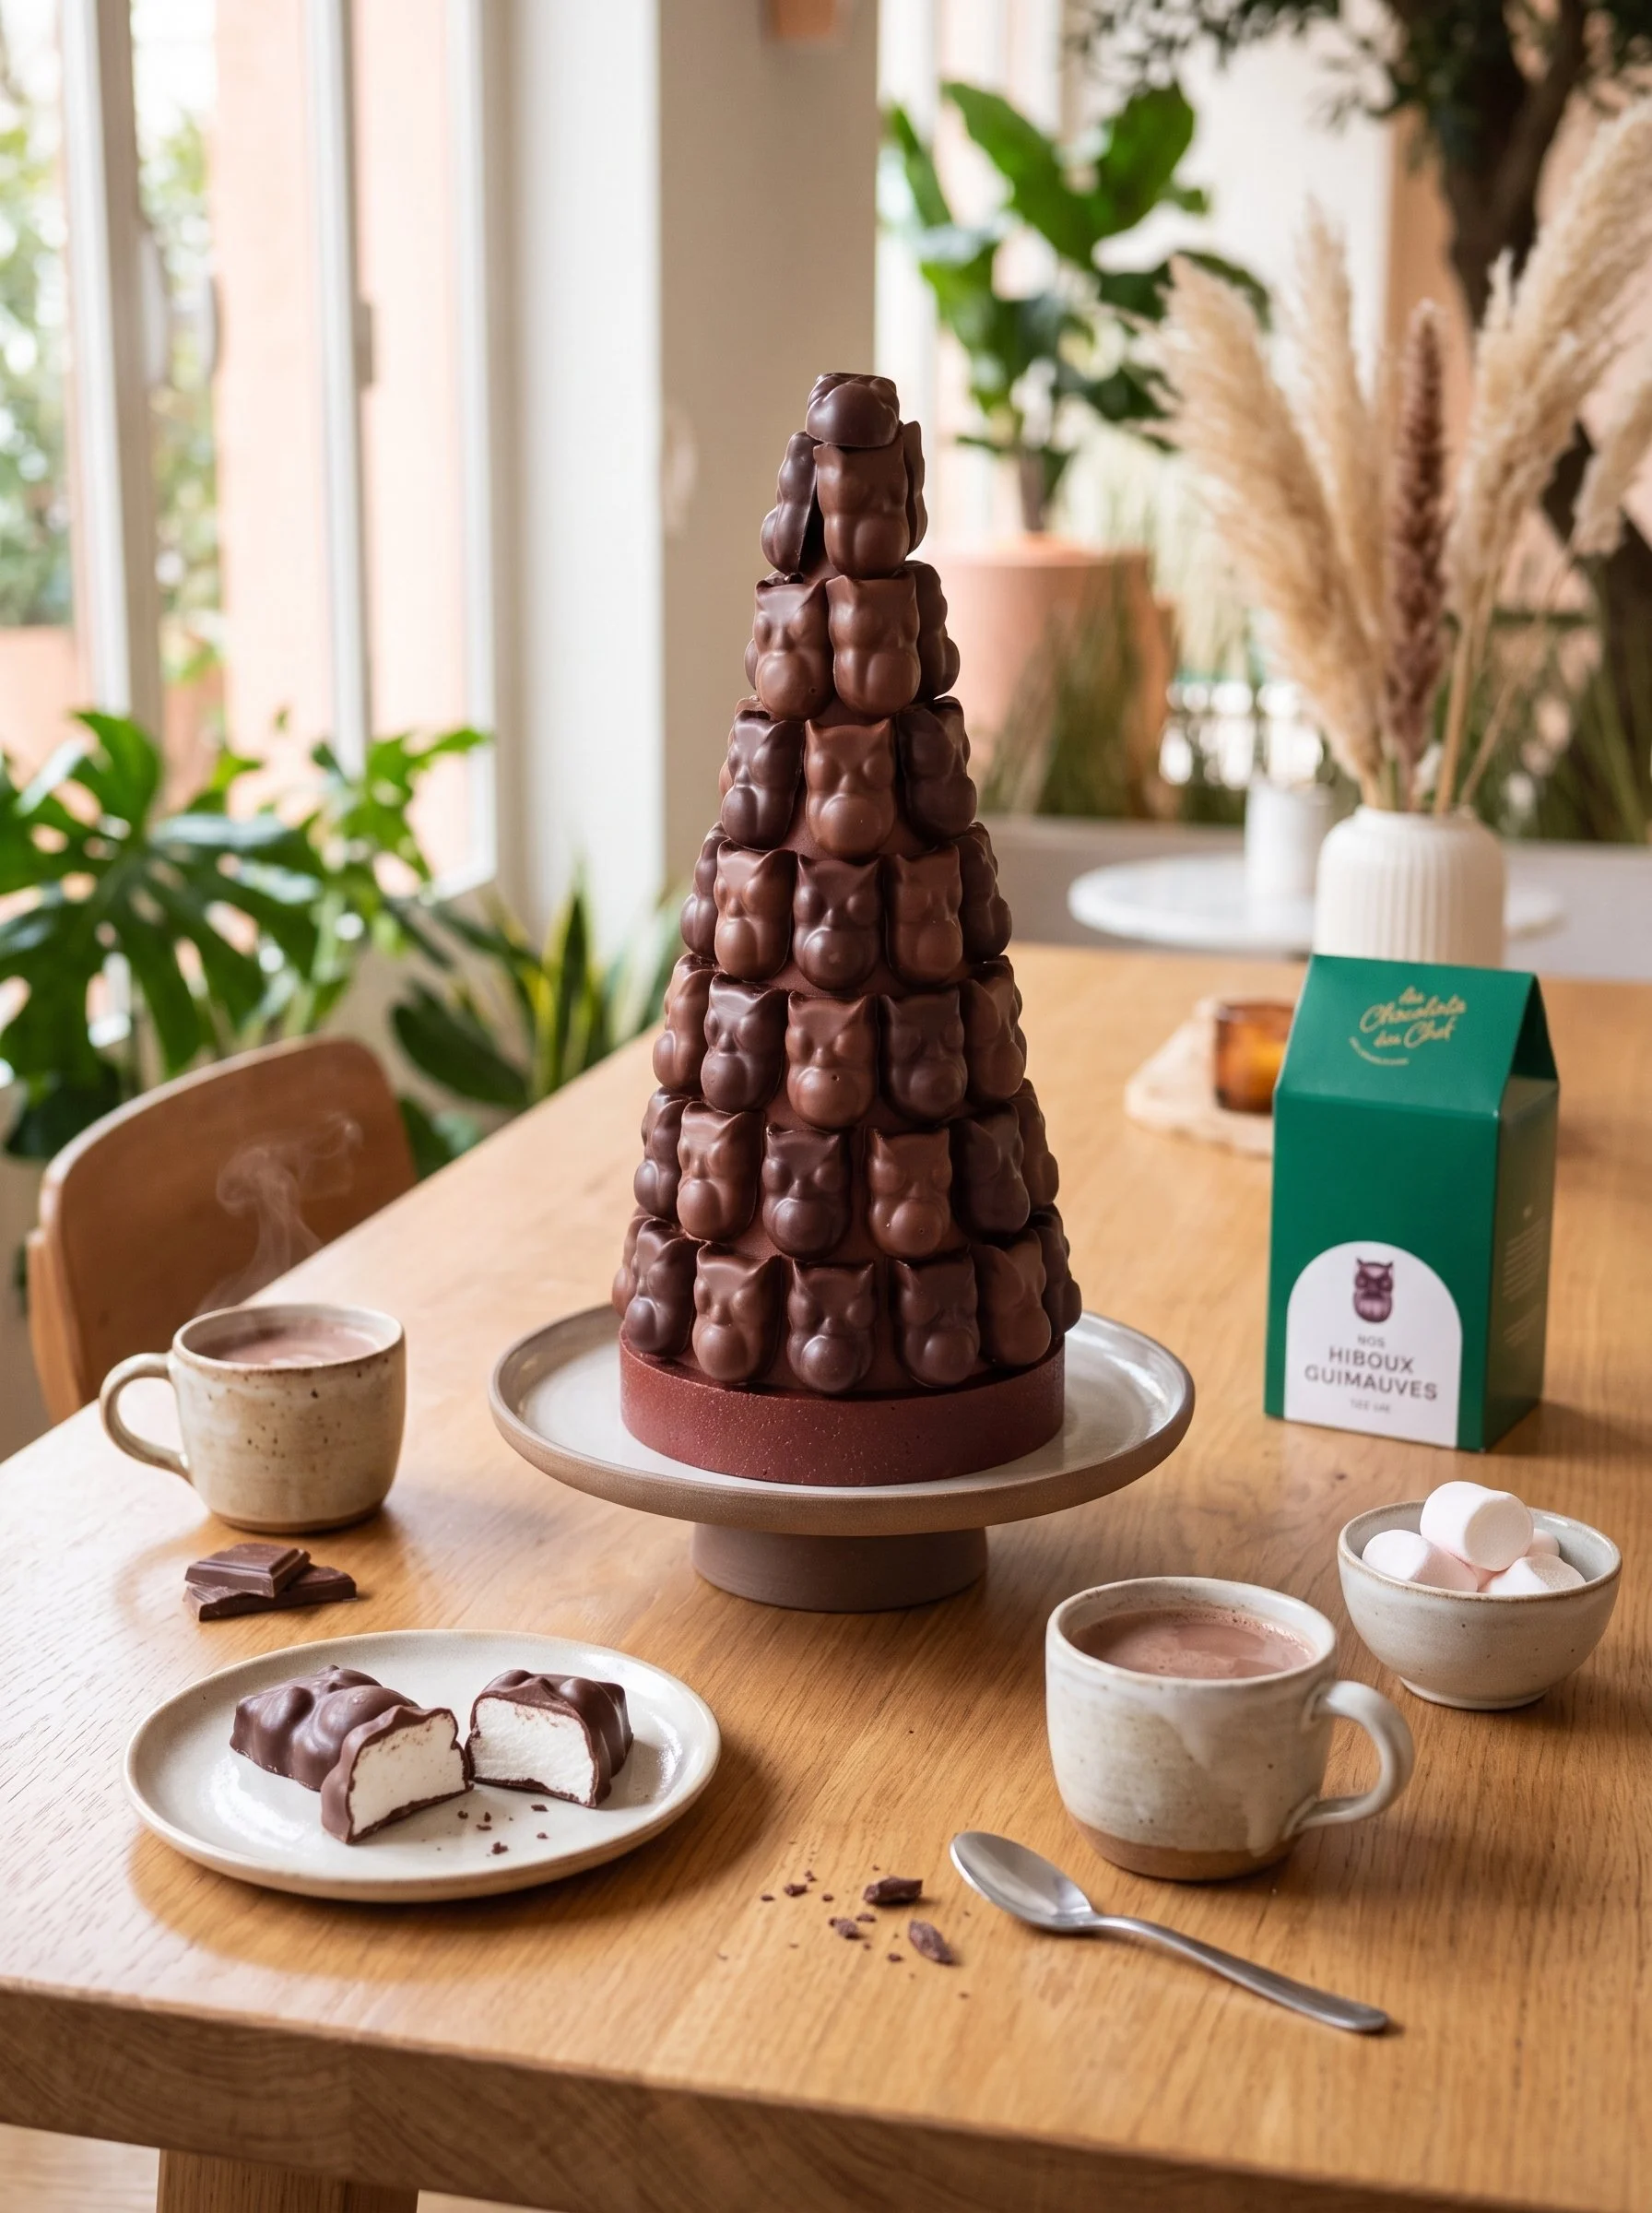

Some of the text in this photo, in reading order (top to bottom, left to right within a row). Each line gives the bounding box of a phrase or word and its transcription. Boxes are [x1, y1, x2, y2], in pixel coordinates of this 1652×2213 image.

[1357, 1334, 1386, 1348] NOS
[1328, 1346, 1414, 1374] HIBOUX
[1304, 1365, 1438, 1401] GUIMAUVES
